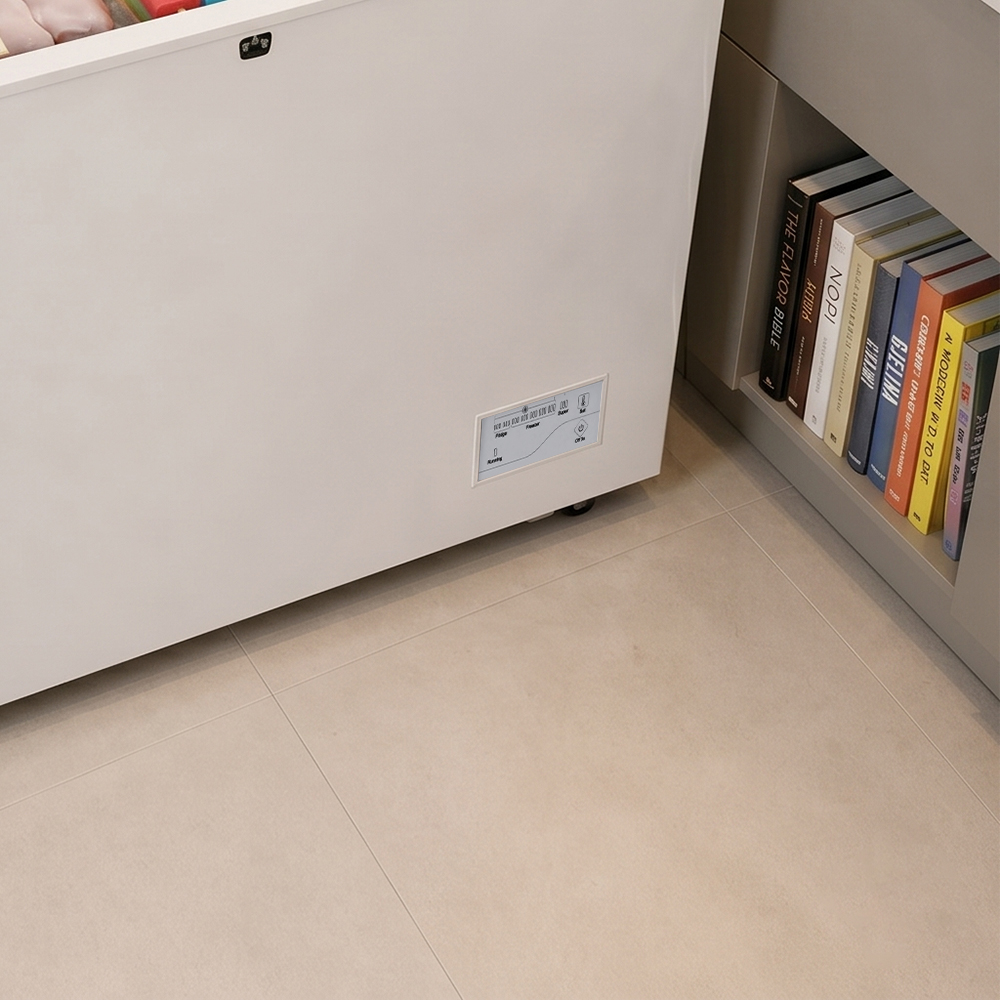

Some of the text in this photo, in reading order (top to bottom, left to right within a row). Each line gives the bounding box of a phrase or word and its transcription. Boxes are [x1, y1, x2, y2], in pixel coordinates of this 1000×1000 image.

[769, 210, 799, 351] THE FLAVOR BIBLE
[824, 265, 843, 325] NOPI
